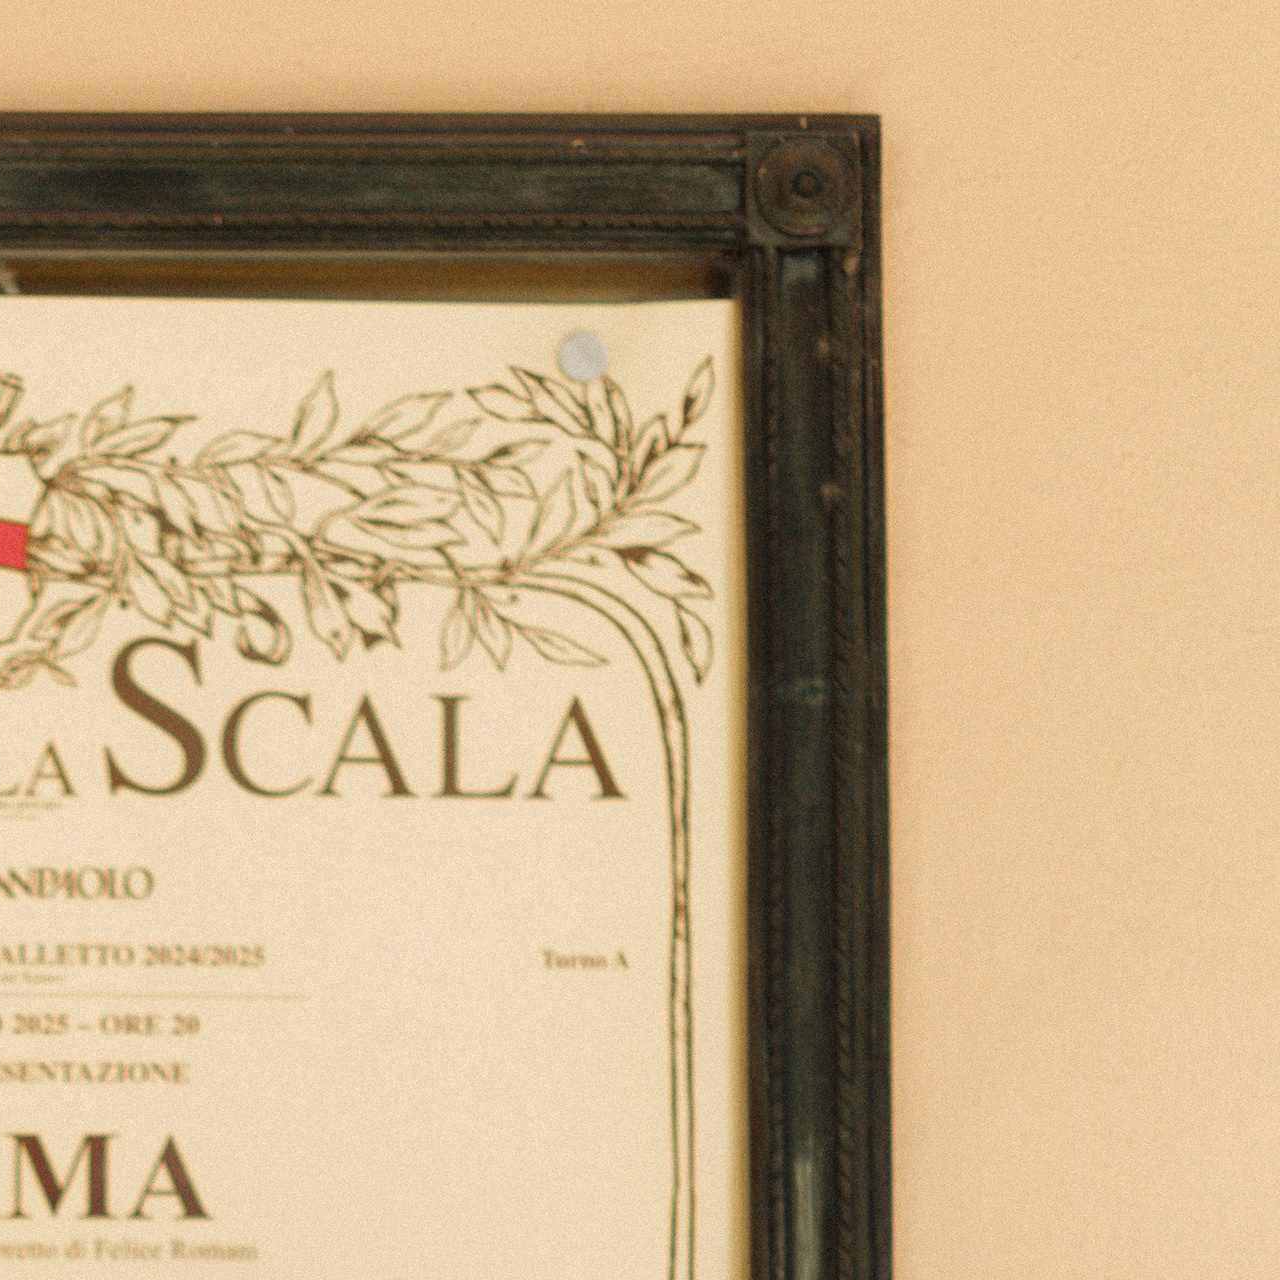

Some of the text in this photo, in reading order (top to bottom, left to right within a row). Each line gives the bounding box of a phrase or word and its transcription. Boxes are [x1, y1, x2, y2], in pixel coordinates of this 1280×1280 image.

[104, 636, 626, 800] SCALA
[143, 944, 265, 968] 2024/2025
[616, 951, 629, 969] A
[12, 1013, 69, 1036] 2025
[99, 1013, 157, 1036] ORE
[171, 1013, 201, 1037] 20
[63, 1238, 88, 1260] di
[92, 1237, 163, 1261] Felice
[169, 1238, 259, 1262] Romani
